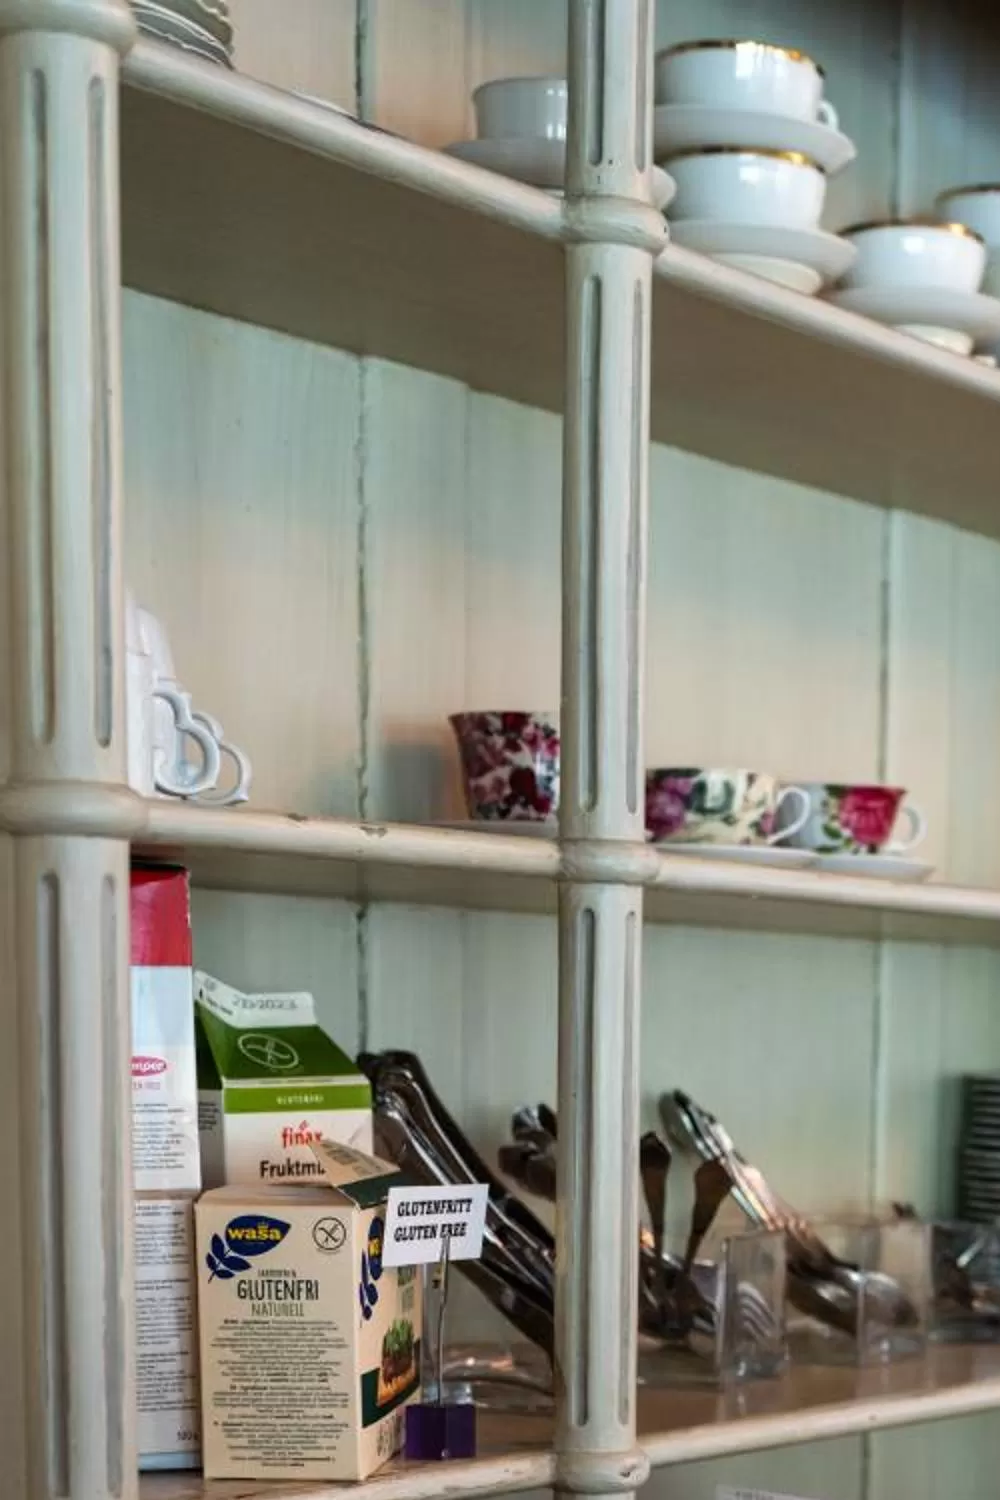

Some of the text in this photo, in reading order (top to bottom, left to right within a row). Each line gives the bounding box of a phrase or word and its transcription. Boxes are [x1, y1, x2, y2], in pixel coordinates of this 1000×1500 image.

[281, 1127, 323, 1147] finax
[259, 1159, 326, 1178] Fruktmi
[397, 1198, 473, 1217] GLUTENFRITT
[227, 1227, 282, 1240] wasa
[394, 1221, 467, 1242] GLUTEN FREE
[237, 1278, 320, 1300] GLUTENFRI
[251, 1302, 305, 1317] NATURELL
